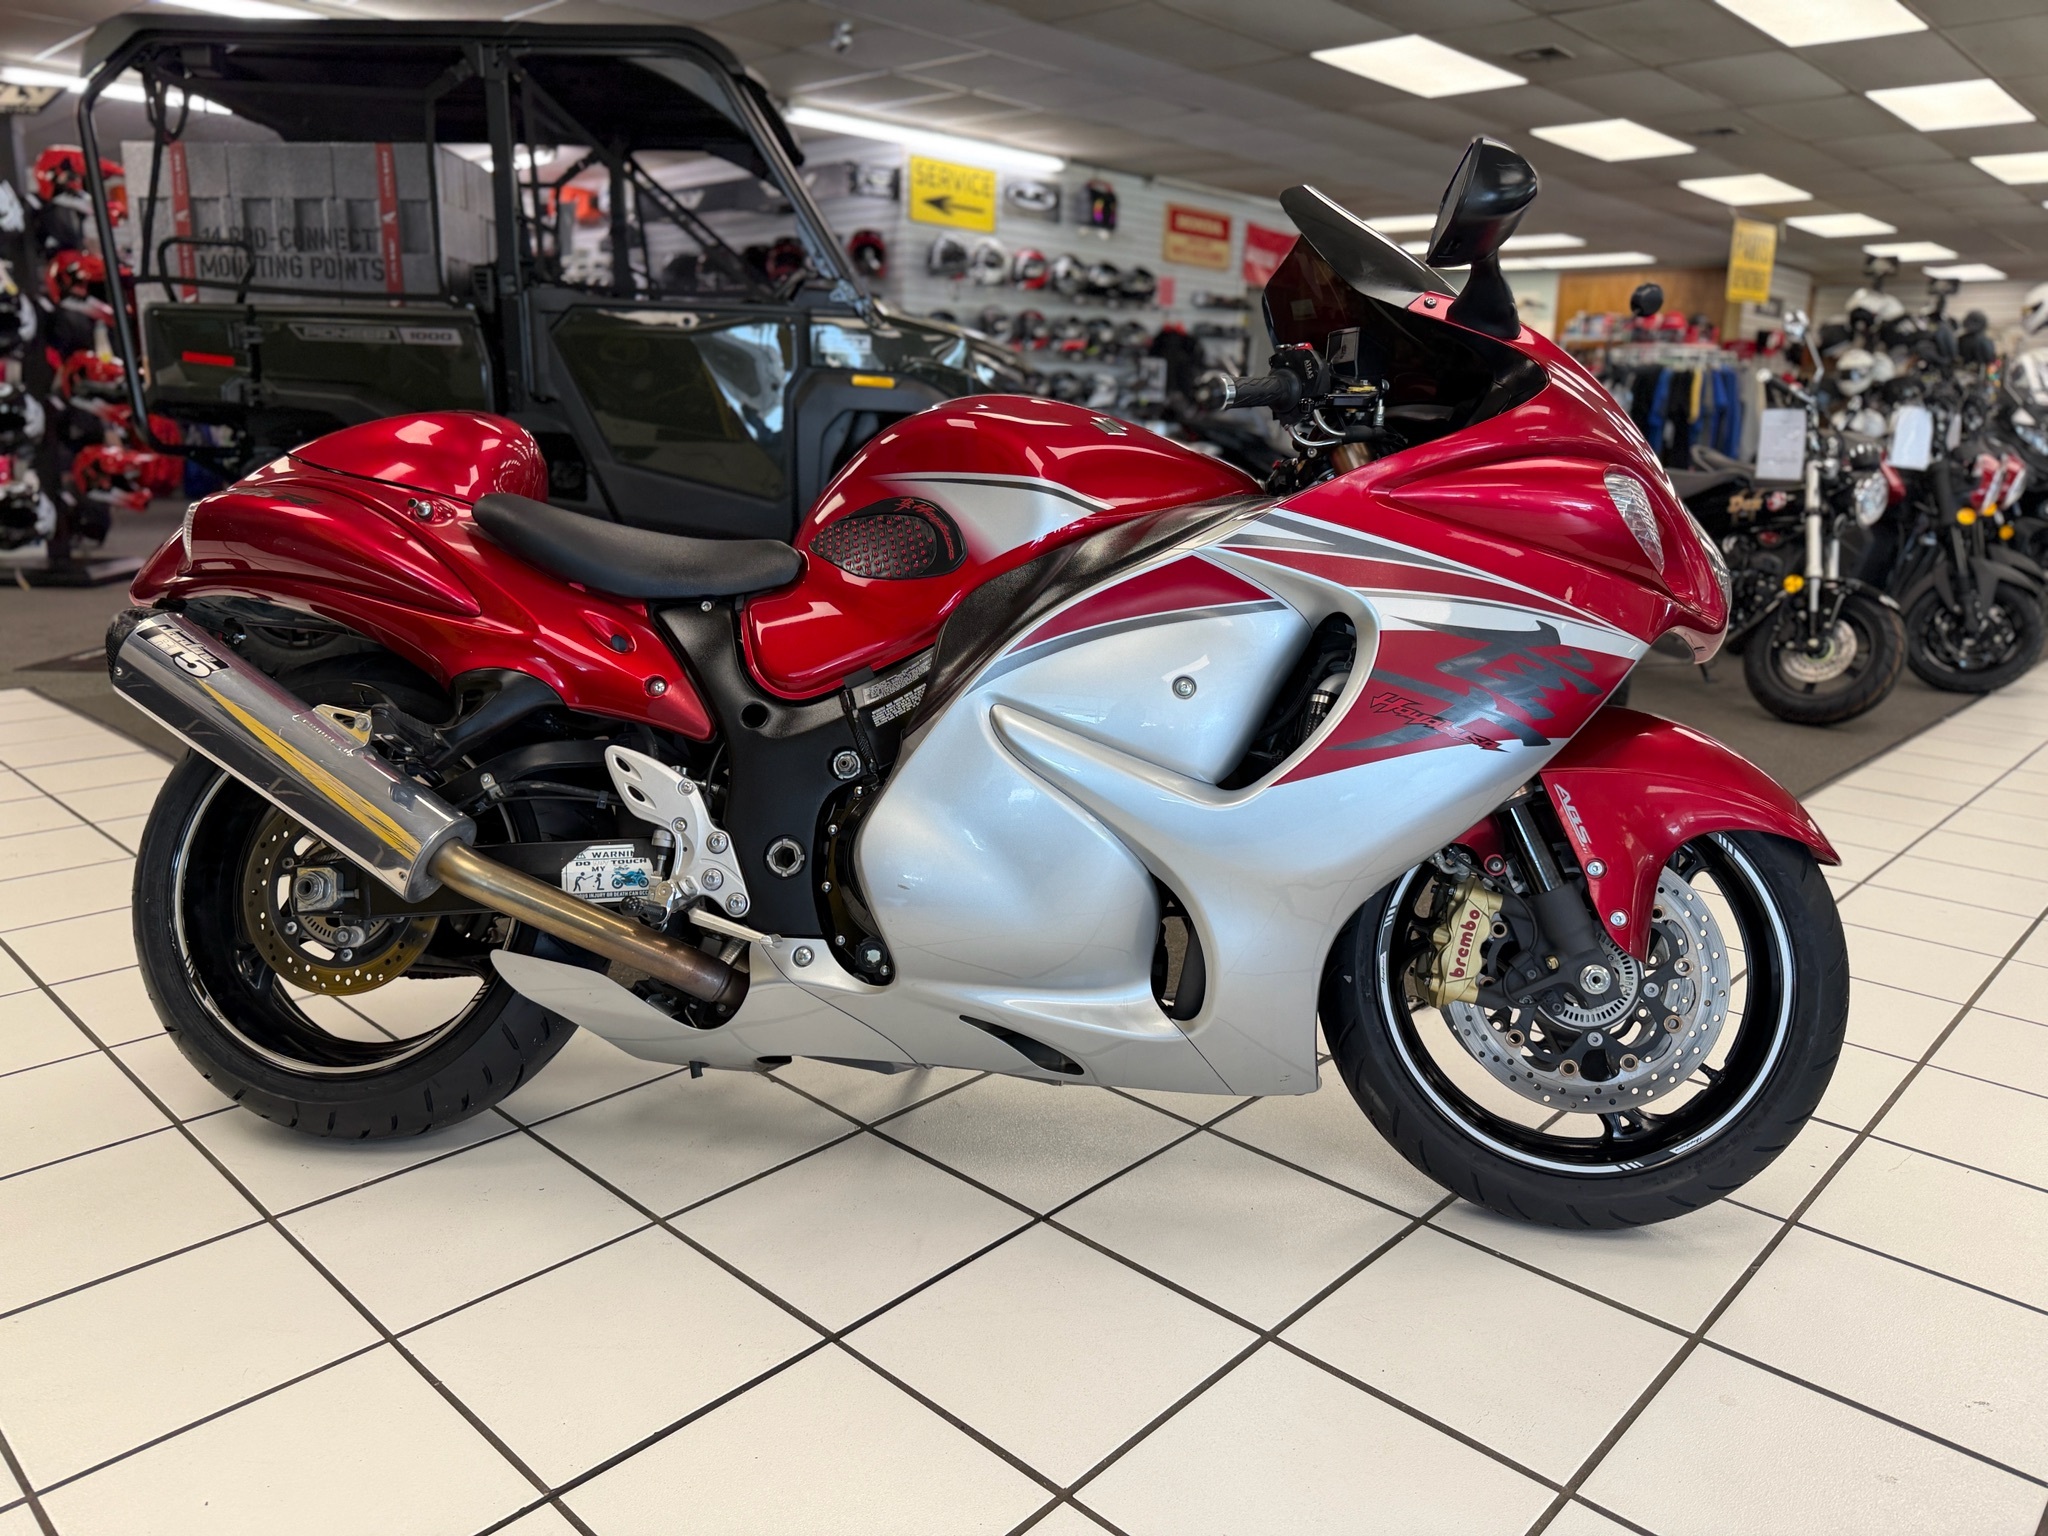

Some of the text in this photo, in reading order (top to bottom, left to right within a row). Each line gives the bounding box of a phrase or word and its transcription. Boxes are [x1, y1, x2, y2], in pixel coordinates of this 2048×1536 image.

[916, 162, 991, 199] SERVICE
[201, 254, 304, 279] MOUTING
[310, 257, 385, 281] POINTS
[410, 332, 453, 341] 1000
[1303, 359, 1315, 380] ATLAS
[1370, 692, 1511, 753] Hayabusa
[1553, 783, 1592, 848] ABS
[1449, 909, 1480, 978] brembo
